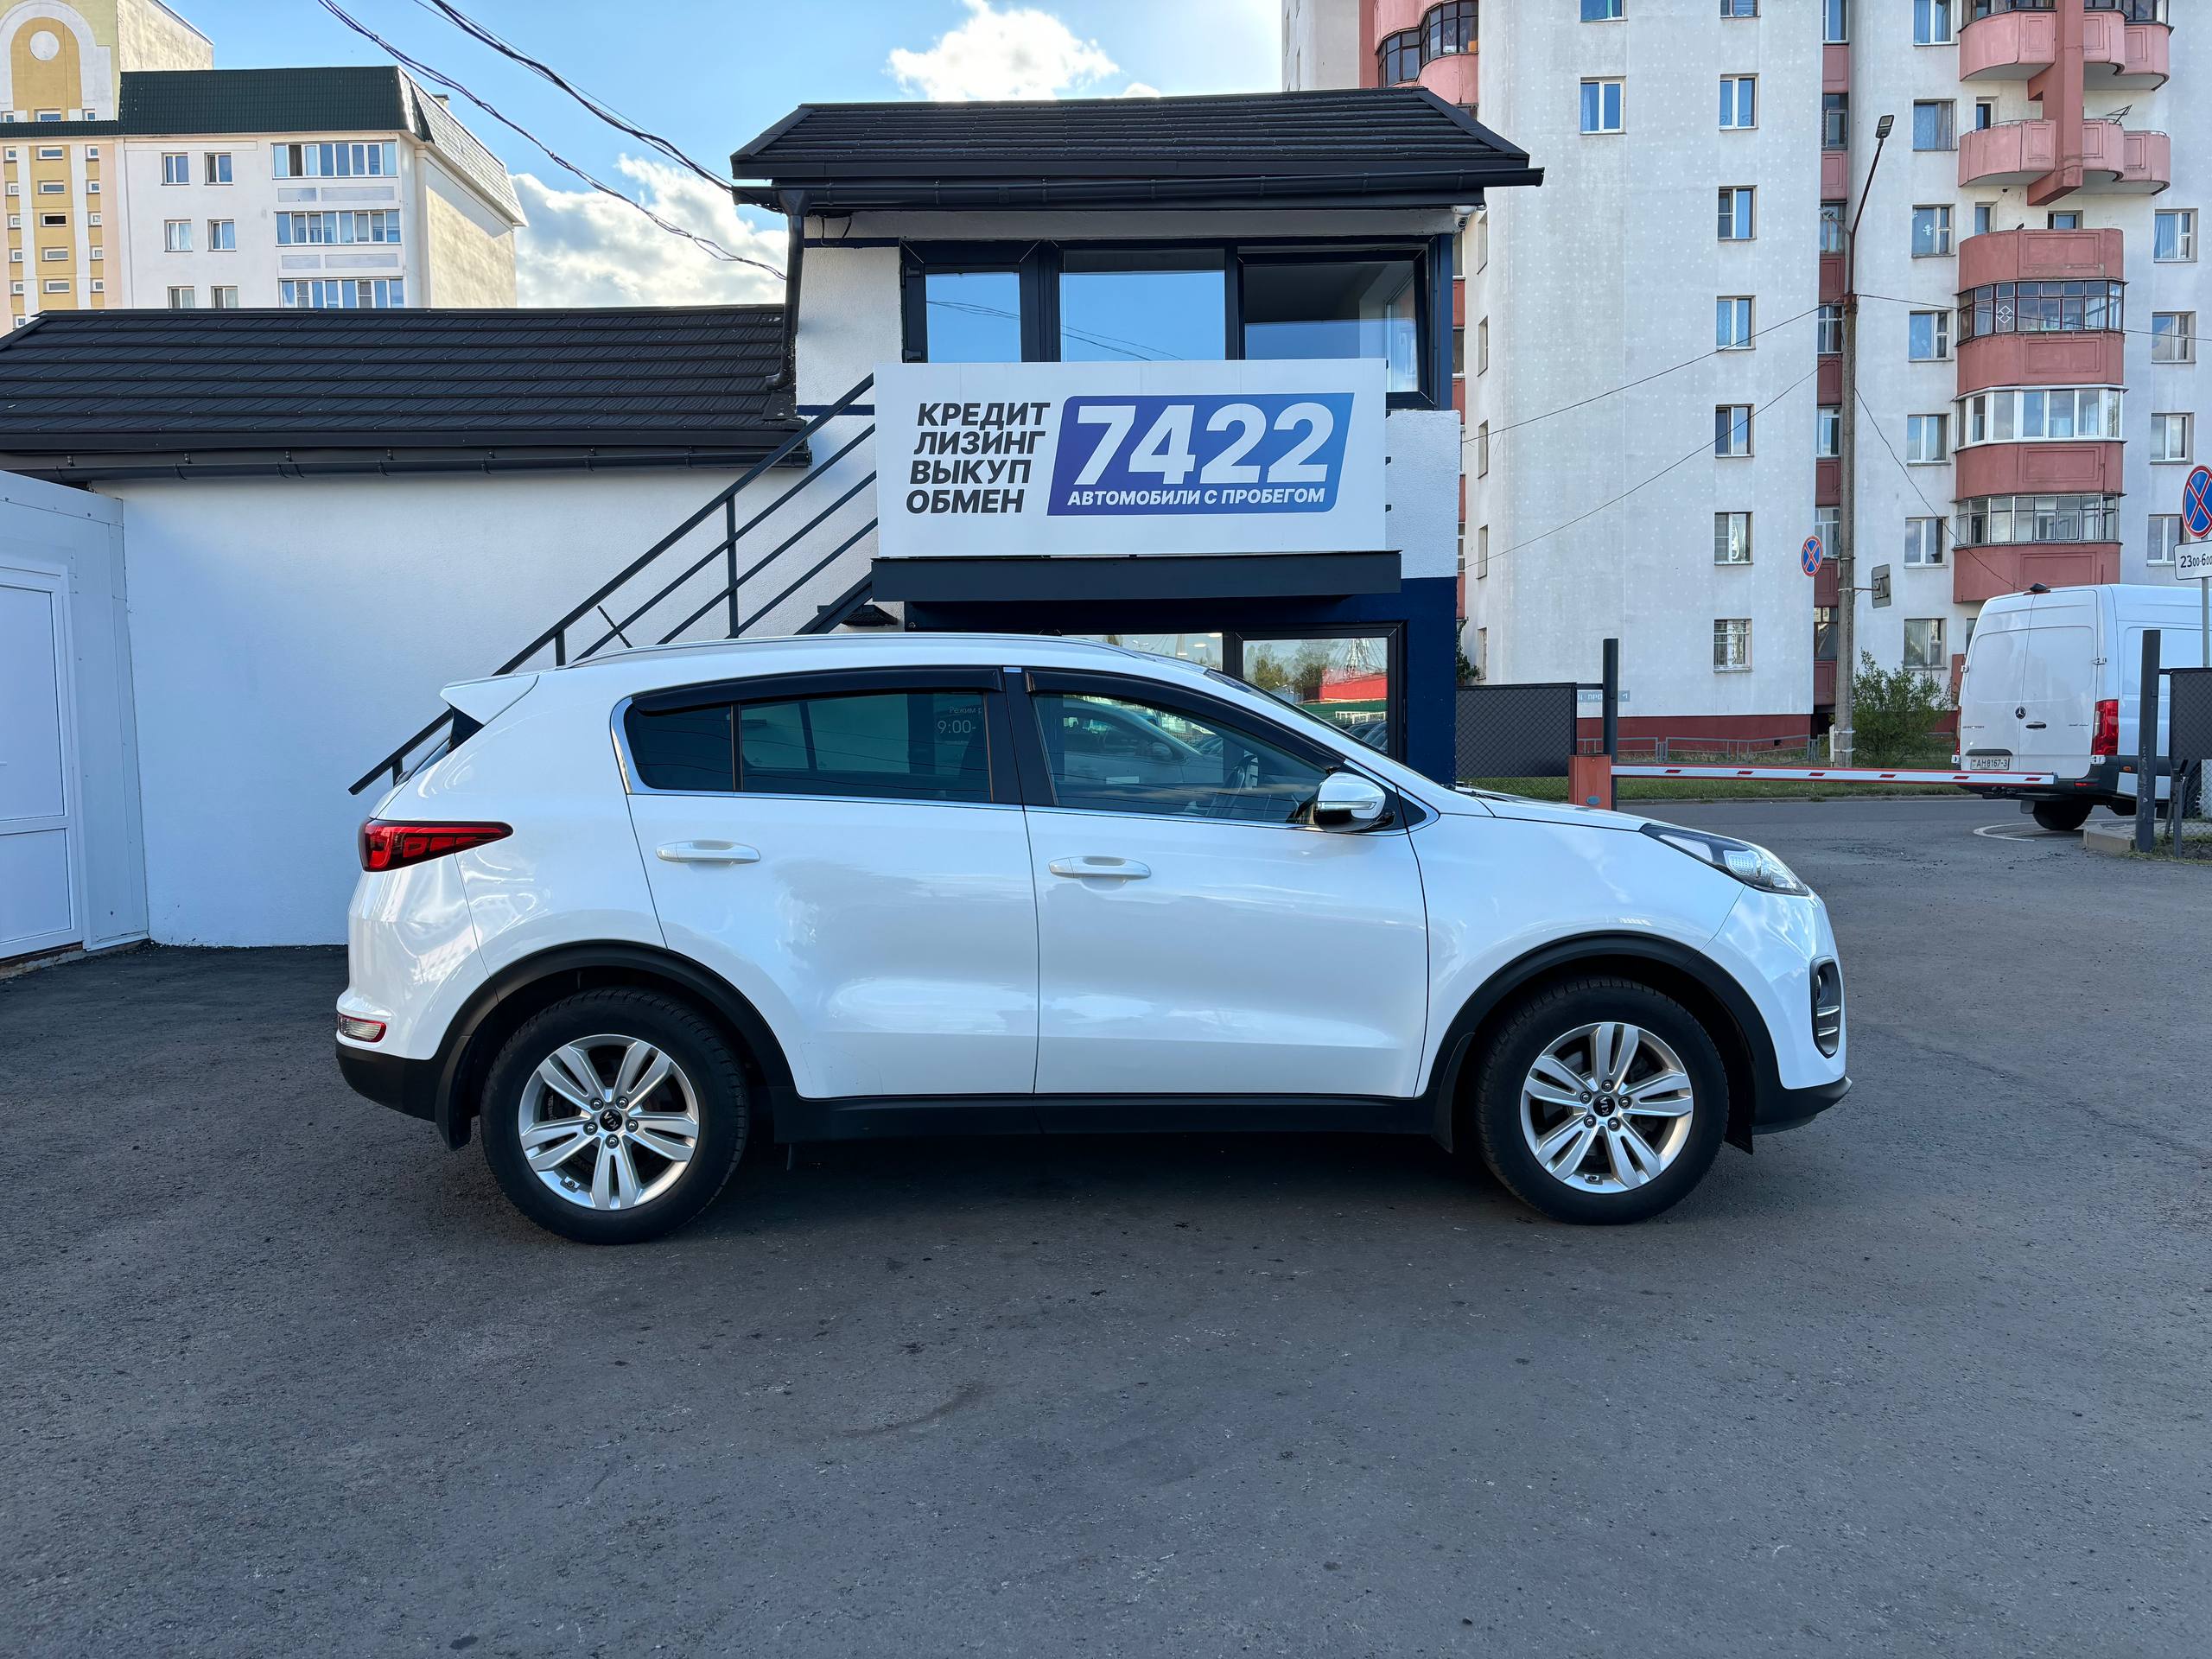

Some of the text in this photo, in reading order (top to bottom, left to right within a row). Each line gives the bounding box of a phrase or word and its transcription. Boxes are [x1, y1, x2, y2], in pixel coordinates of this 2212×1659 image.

[918, 402, 1051, 430] КРЕДИТ
[913, 430, 1046, 455] ЛИЗИНГ
[1073, 402, 1334, 486] 7422
[909, 459, 1032, 485] ВЫКУП
[906, 488, 1025, 514] ОБМЕН
[1067, 487, 1325, 505] АВТОМОБИЛИ С ПРОБЕГОМ
[1600, 1096, 1610, 1115] KIA
[604, 1111, 619, 1128] KIA
